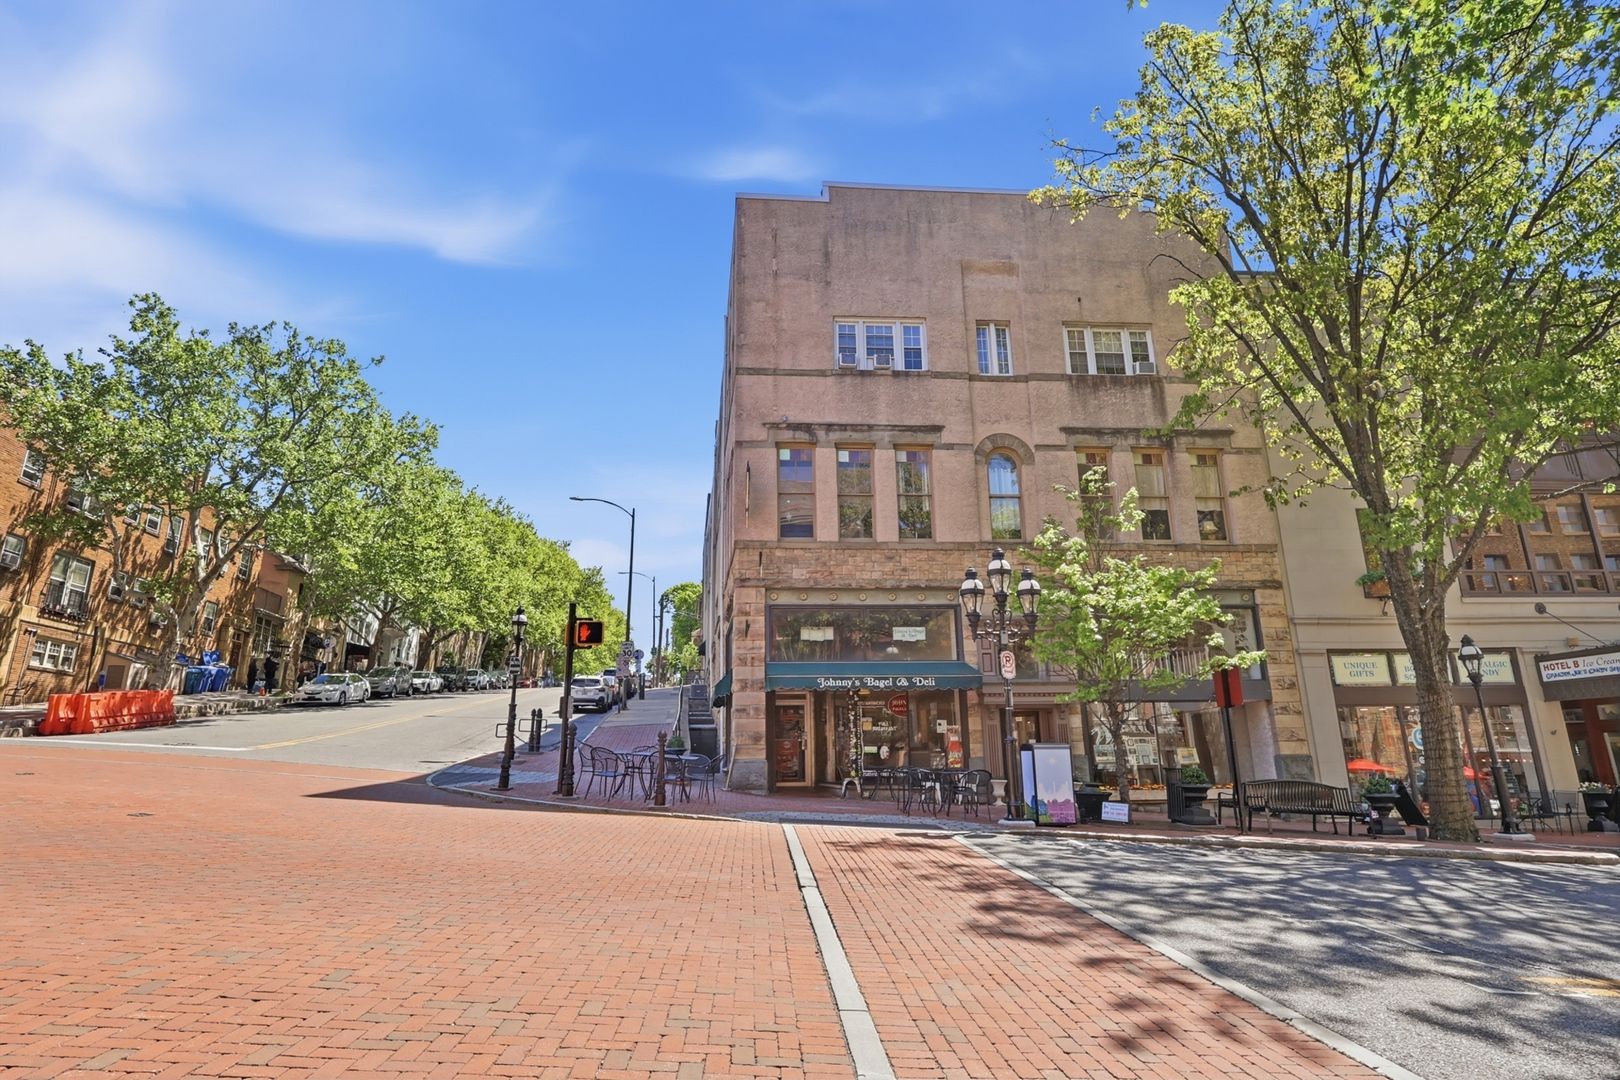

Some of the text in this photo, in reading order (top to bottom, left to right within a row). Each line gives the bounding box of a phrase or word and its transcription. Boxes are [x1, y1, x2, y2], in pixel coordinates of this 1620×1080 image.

[1343, 662, 1377, 670] UNIQUE
[1543, 661, 1571, 672] HOTEL
[1573, 660, 1580, 669] B
[1349, 670, 1375, 678] GIFTS
[817, 677, 935, 688] Johnny's Bagel & Deli
